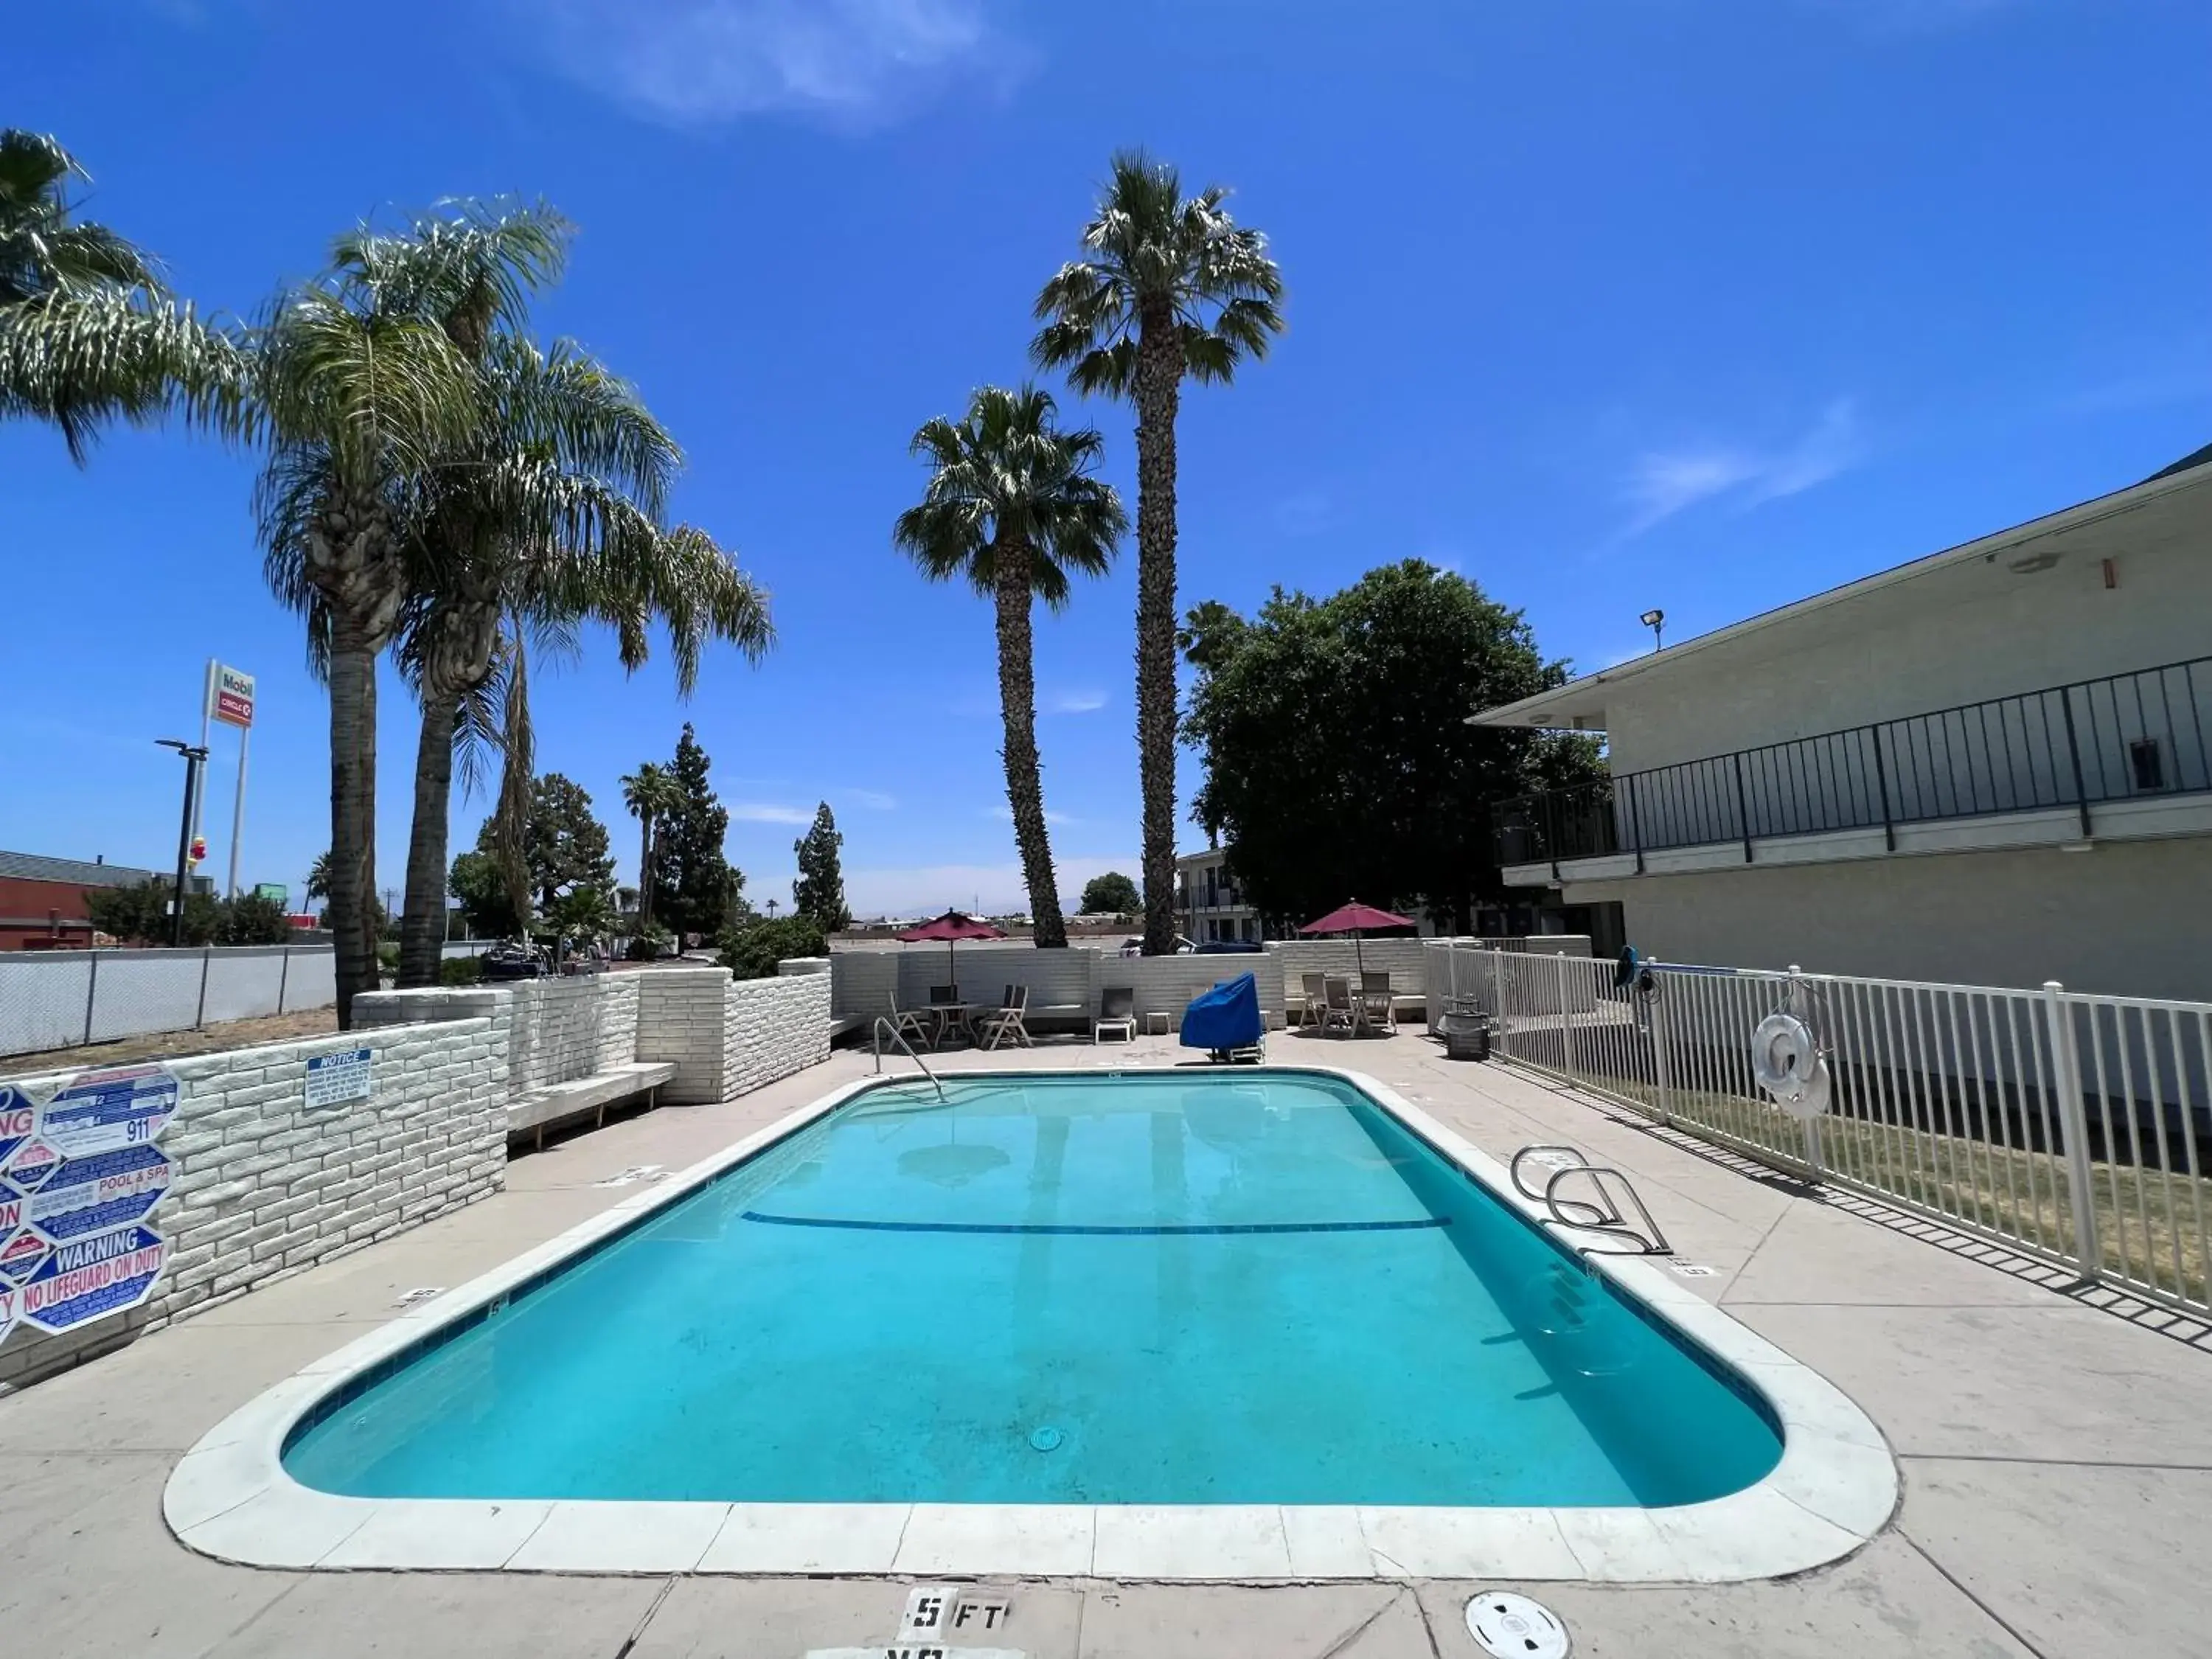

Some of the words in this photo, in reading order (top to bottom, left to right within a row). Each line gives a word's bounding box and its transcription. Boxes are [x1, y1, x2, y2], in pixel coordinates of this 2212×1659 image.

[223, 673, 253, 698] Mobil
[320, 1052, 360, 1067] NOTICE
[127, 1118, 150, 1142] 911
[100, 1175, 133, 1192] POOL
[136, 1172, 145, 1182] &
[147, 1165, 170, 1180] SPA
[56, 1228, 138, 1273] WARNING
[24, 1286, 43, 1311] NO
[47, 1262, 111, 1304] LIFEGUARD
[115, 1256, 131, 1279] ON
[135, 1244, 164, 1274] DUTY
[913, 1598, 942, 1627] 5
[955, 1604, 1002, 1629] FT
